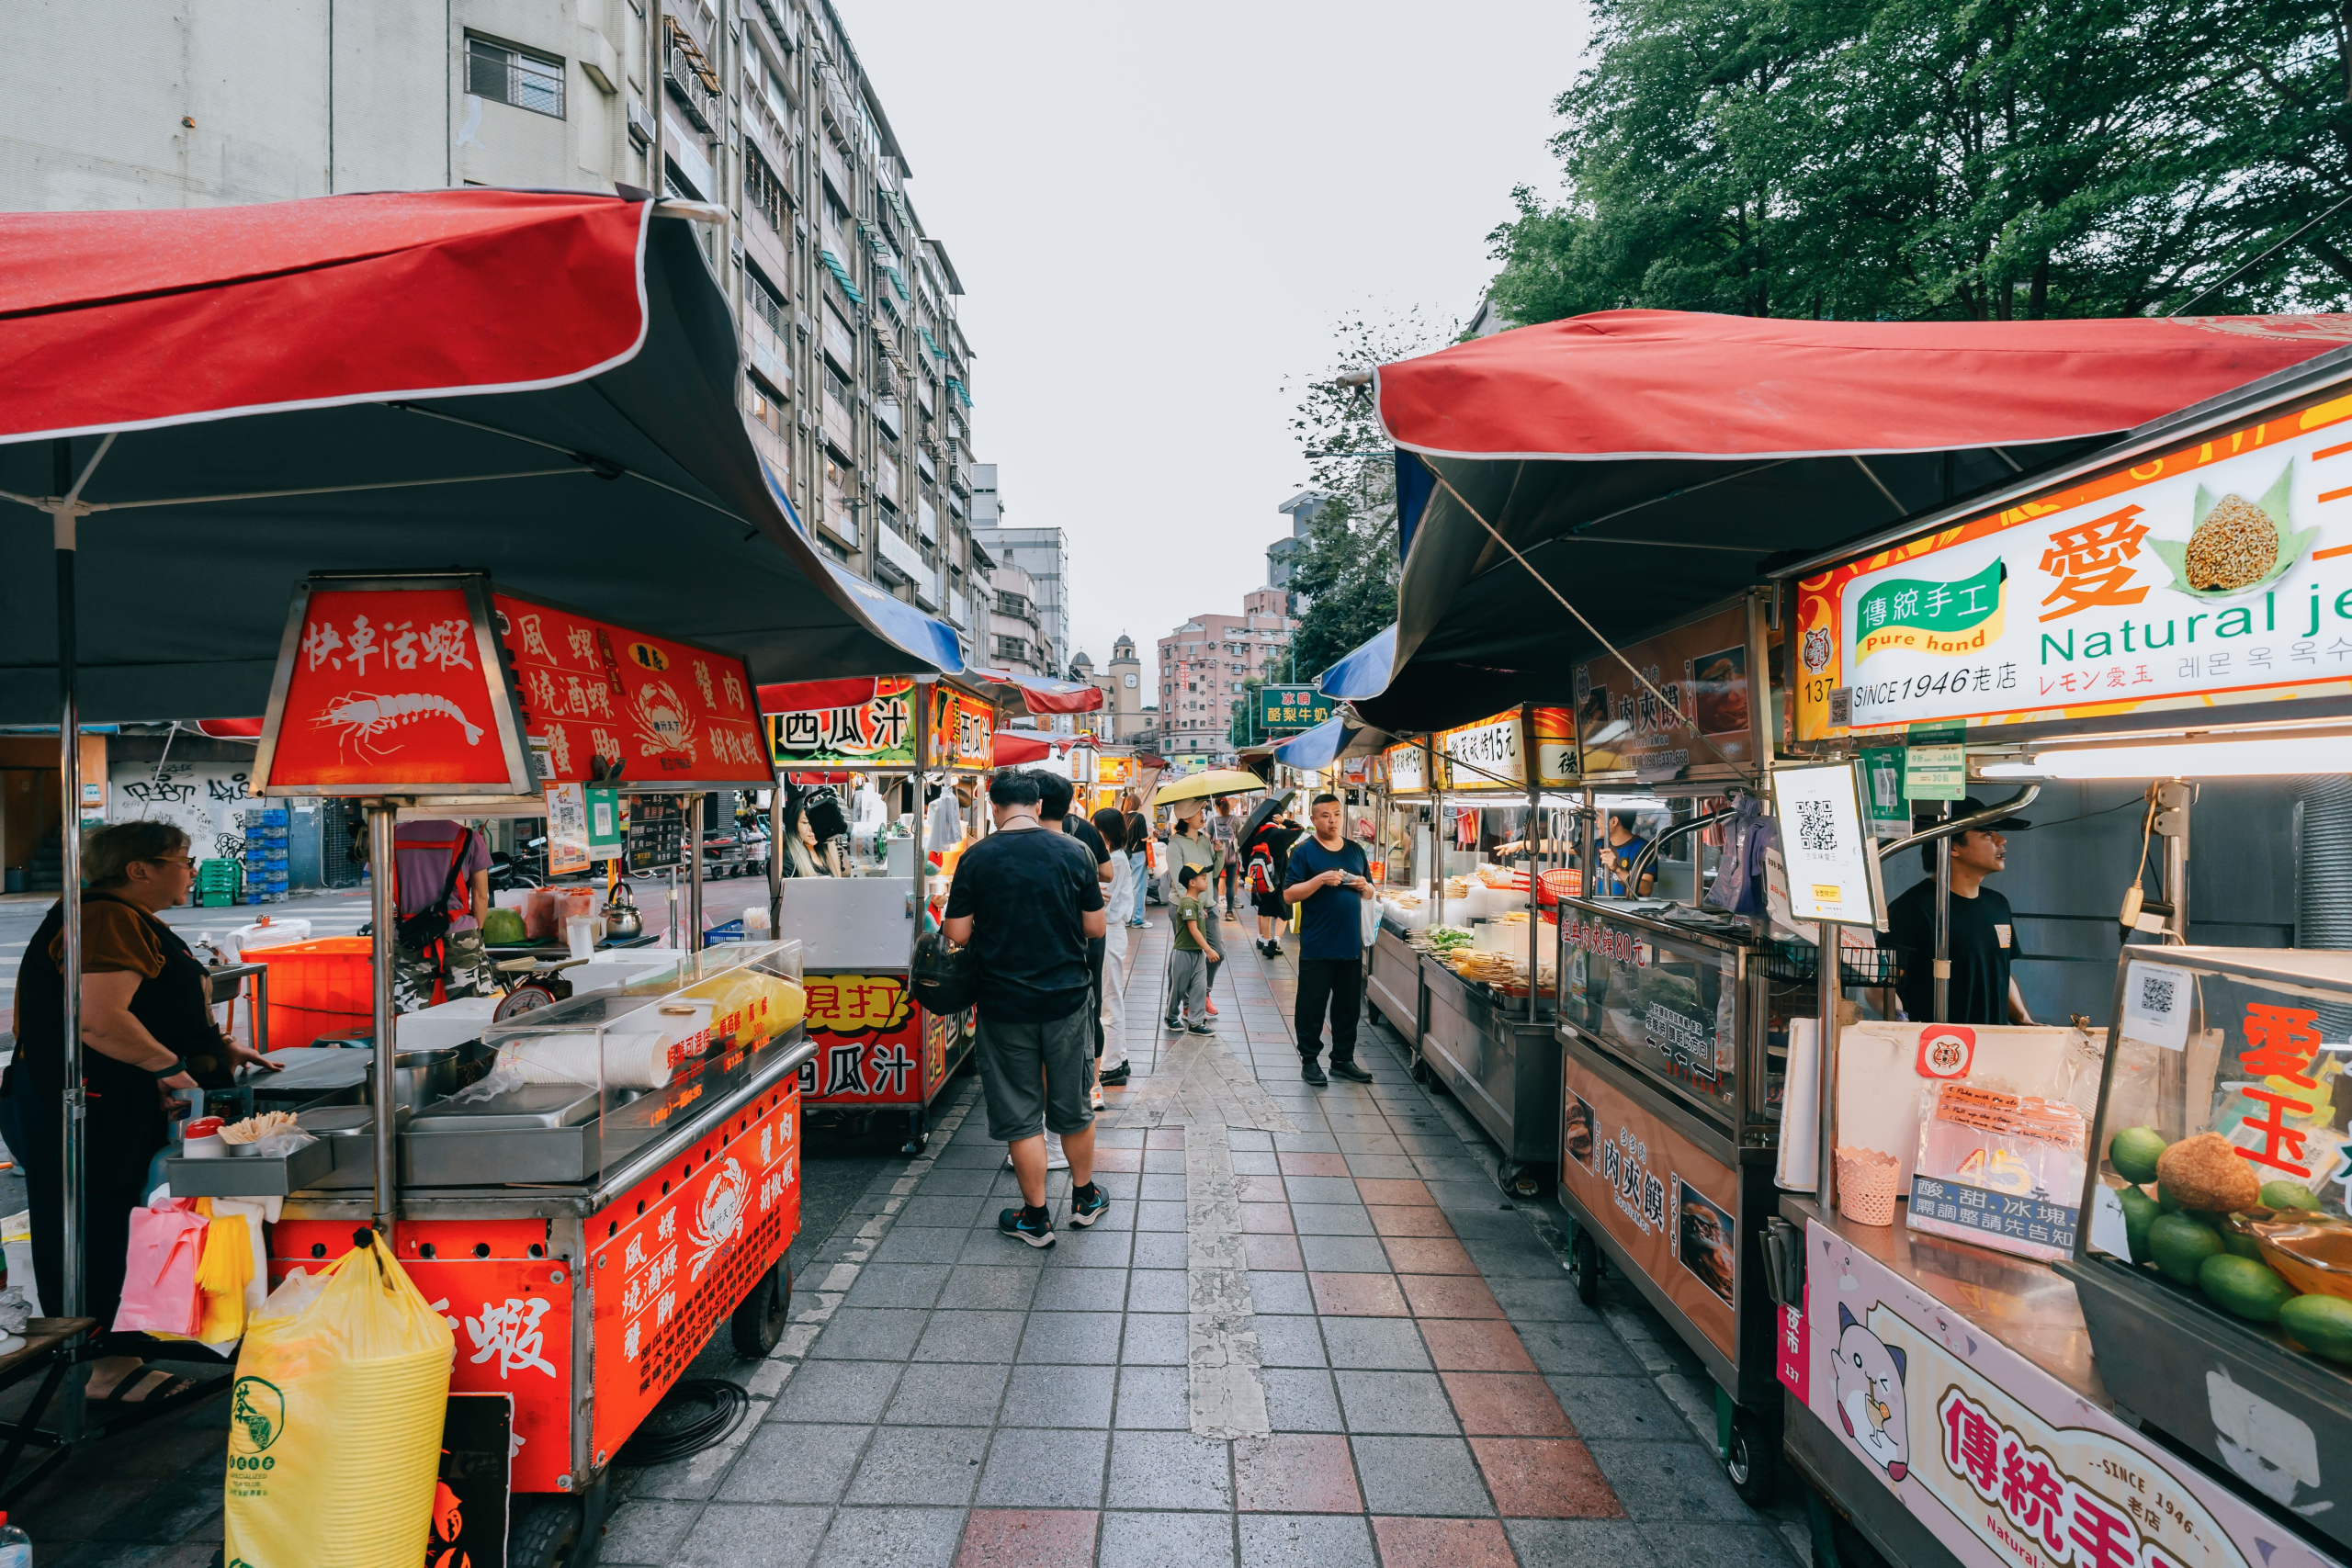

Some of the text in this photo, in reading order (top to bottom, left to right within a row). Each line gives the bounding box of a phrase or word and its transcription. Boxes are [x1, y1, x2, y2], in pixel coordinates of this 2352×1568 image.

[2038, 503, 2152, 624] 愛
[1862, 582, 1990, 629] 傳統手工
[2041, 591, 2276, 666] Natural
[302, 614, 474, 677] 快車活蝦
[517, 613, 600, 671] 風螺
[1866, 628, 1985, 653] Pure hand
[2178, 651, 2232, 680] 레몬
[2247, 646, 2273, 671] 옥
[529, 669, 615, 720] 燒酒螺
[692, 659, 745, 712] 蟹肉
[1804, 677, 1835, 705] 137
[1902, 668, 1971, 701] 1946
[1972, 661, 2018, 693] 老店
[2040, 664, 2154, 696] レモン愛玉
[784, 700, 910, 748] 西瓜汁
[961, 712, 991, 761] 西瓜汁
[1267, 706, 1329, 723] 酪梨牛奶
[1184, 908, 1193, 917] 10
[1561, 917, 1646, 968] 經典肉夾饃80元
[2233, 1002, 2323, 1179] 愛玉
[1620, 1125, 1647, 1166] 多多肉
[1602, 1137, 1665, 1234] 肉夾饃
[1613, 1190, 1651, 1236] RouJiaMou
[1915, 1197, 2074, 1247] 需調整請先告知
[625, 1205, 677, 1275] 風螺
[621, 1243, 679, 1320] 燒酒螺
[1784, 1362, 1800, 1384] 137
[1945, 1397, 2180, 1568] 傳統手
[2127, 1495, 2161, 1533] 老店
